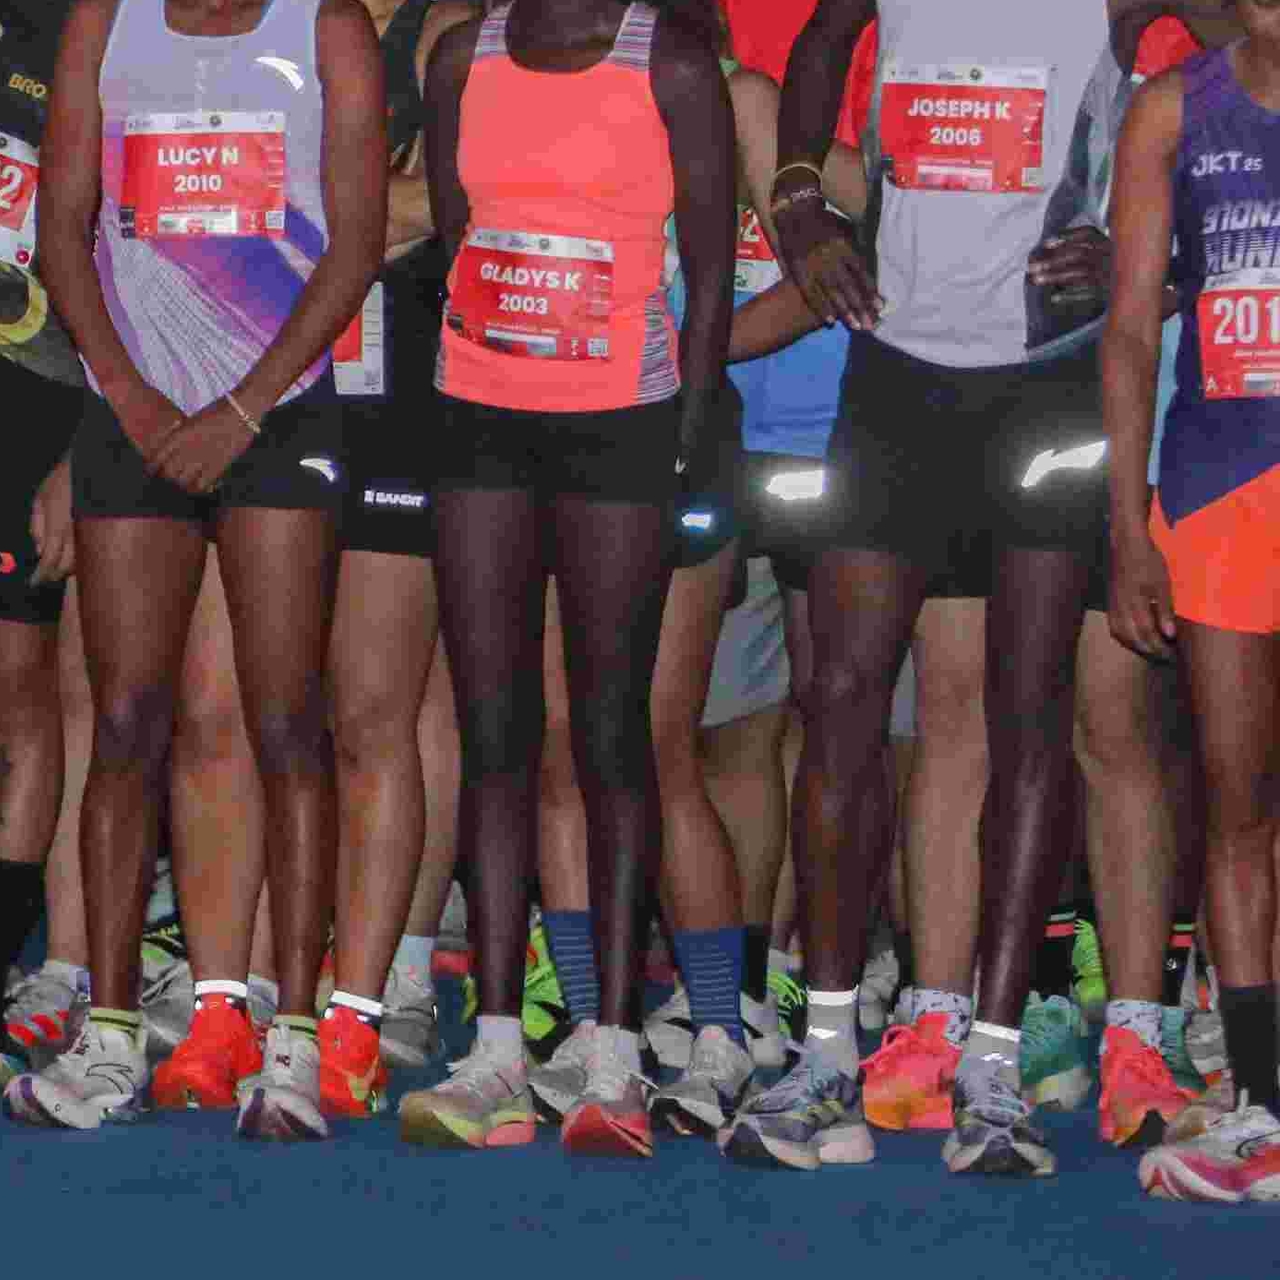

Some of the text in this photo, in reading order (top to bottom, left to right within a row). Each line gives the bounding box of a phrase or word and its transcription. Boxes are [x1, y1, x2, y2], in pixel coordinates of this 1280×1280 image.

[907, 96, 1012, 121] JOSEPH K
[157, 146, 240, 167] LUCY N
[1191, 150, 1243, 177] JKT
[173, 174, 223, 194] 2010
[480, 261, 582, 291] GLADYS K
[497, 293, 549, 316] 2003
